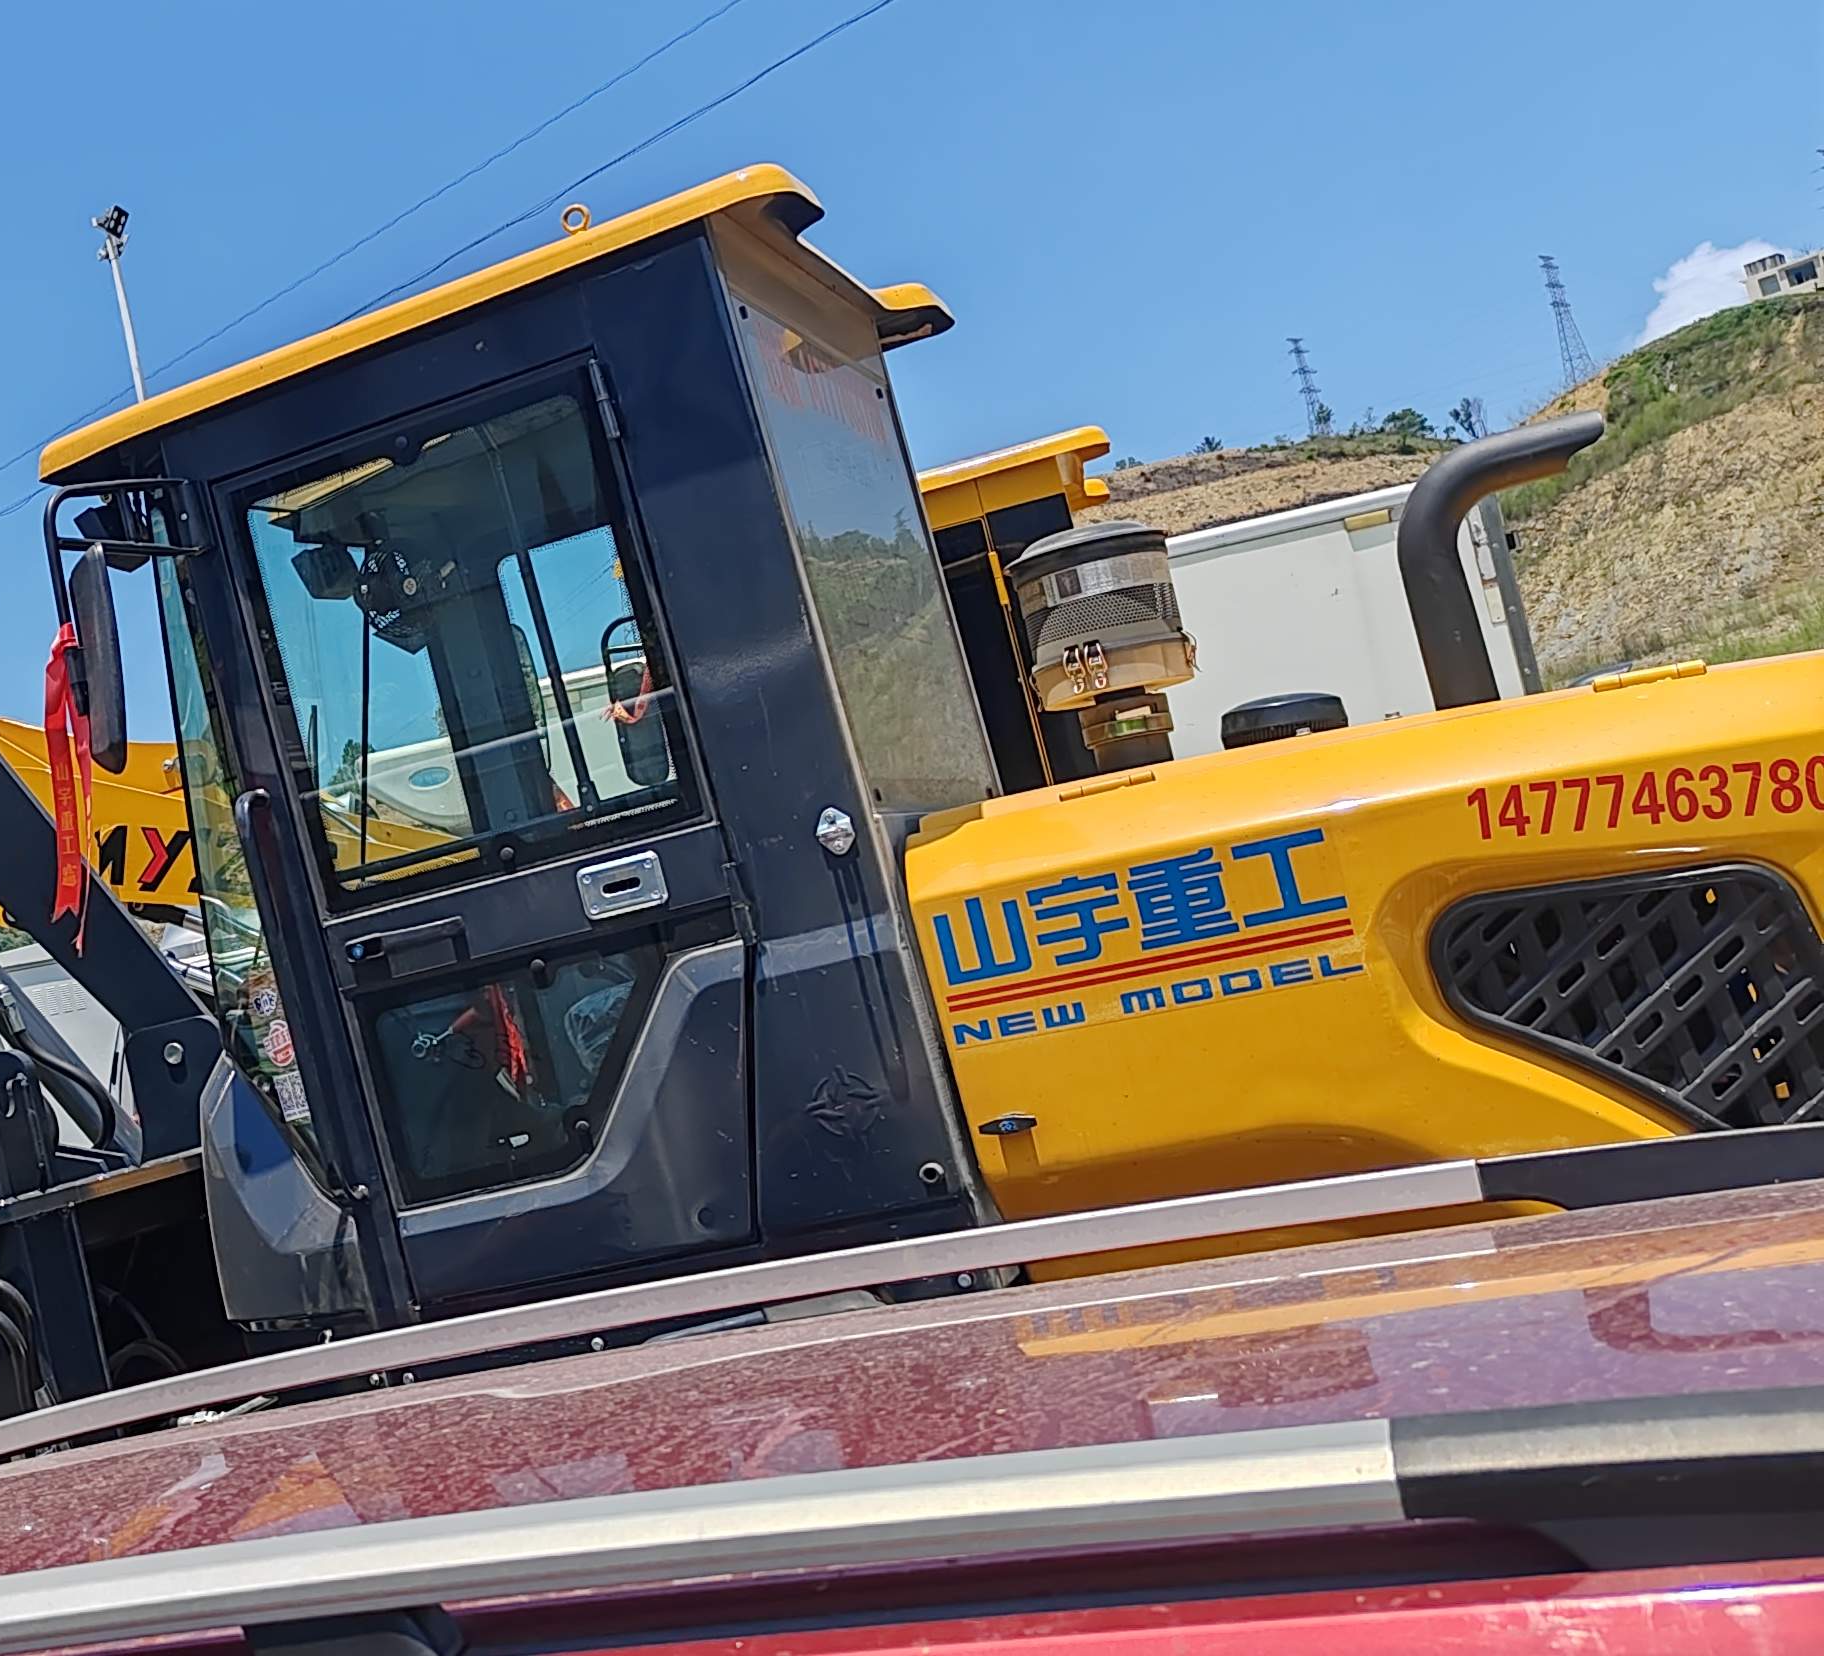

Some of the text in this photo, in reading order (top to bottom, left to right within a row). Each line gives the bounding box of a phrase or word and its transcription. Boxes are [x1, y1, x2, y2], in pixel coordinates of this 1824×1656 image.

[1467, 756, 1824, 840] 14777463780
[933, 827, 1348, 986] 山宇重工
[953, 955, 1365, 1046] NEW MODEL
